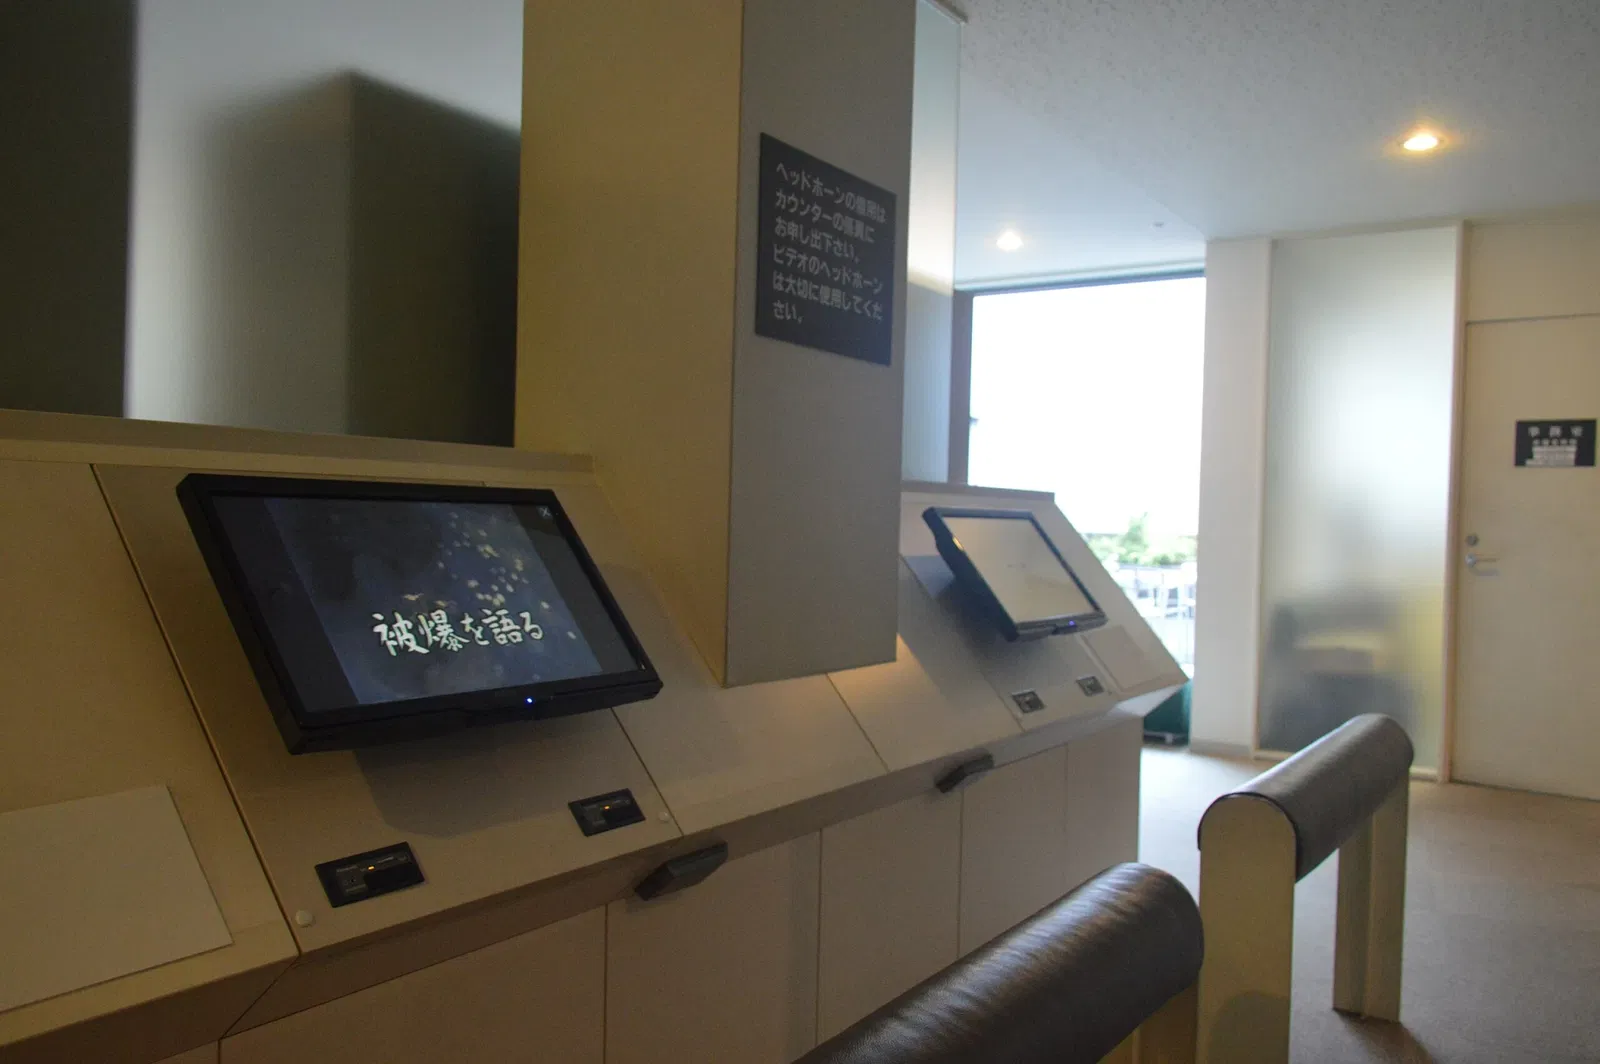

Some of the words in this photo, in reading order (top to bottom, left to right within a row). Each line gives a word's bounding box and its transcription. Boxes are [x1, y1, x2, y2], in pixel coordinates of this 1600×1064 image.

[774, 216, 861, 265] お申し出下さい。
[773, 300, 804, 325] さい。
[372, 608, 544, 657] 被爆を語る
